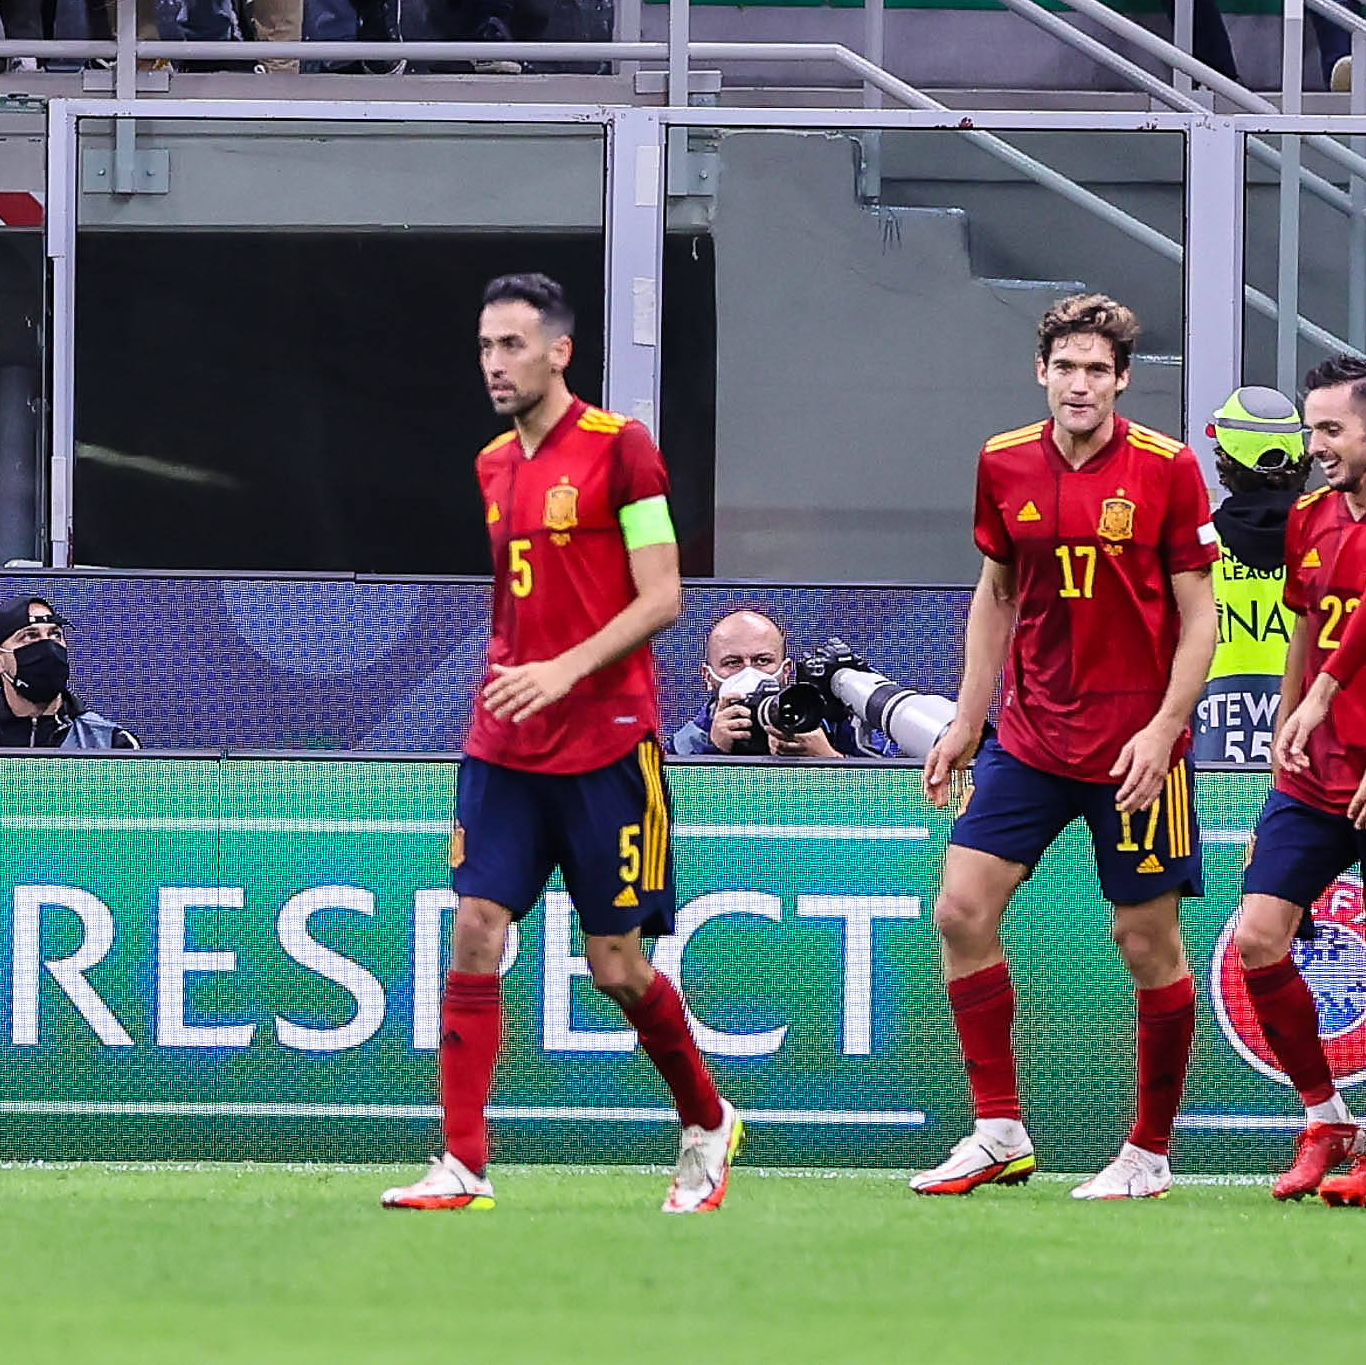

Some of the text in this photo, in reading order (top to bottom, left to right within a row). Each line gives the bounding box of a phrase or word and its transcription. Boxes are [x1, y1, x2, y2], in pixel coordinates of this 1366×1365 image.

[509, 538, 533, 598] 5
[1055, 545, 1096, 598] 17
[1222, 565, 1284, 581] LEAGU
[1197, 692, 1282, 734] STEW
[619, 825, 641, 883] 5
